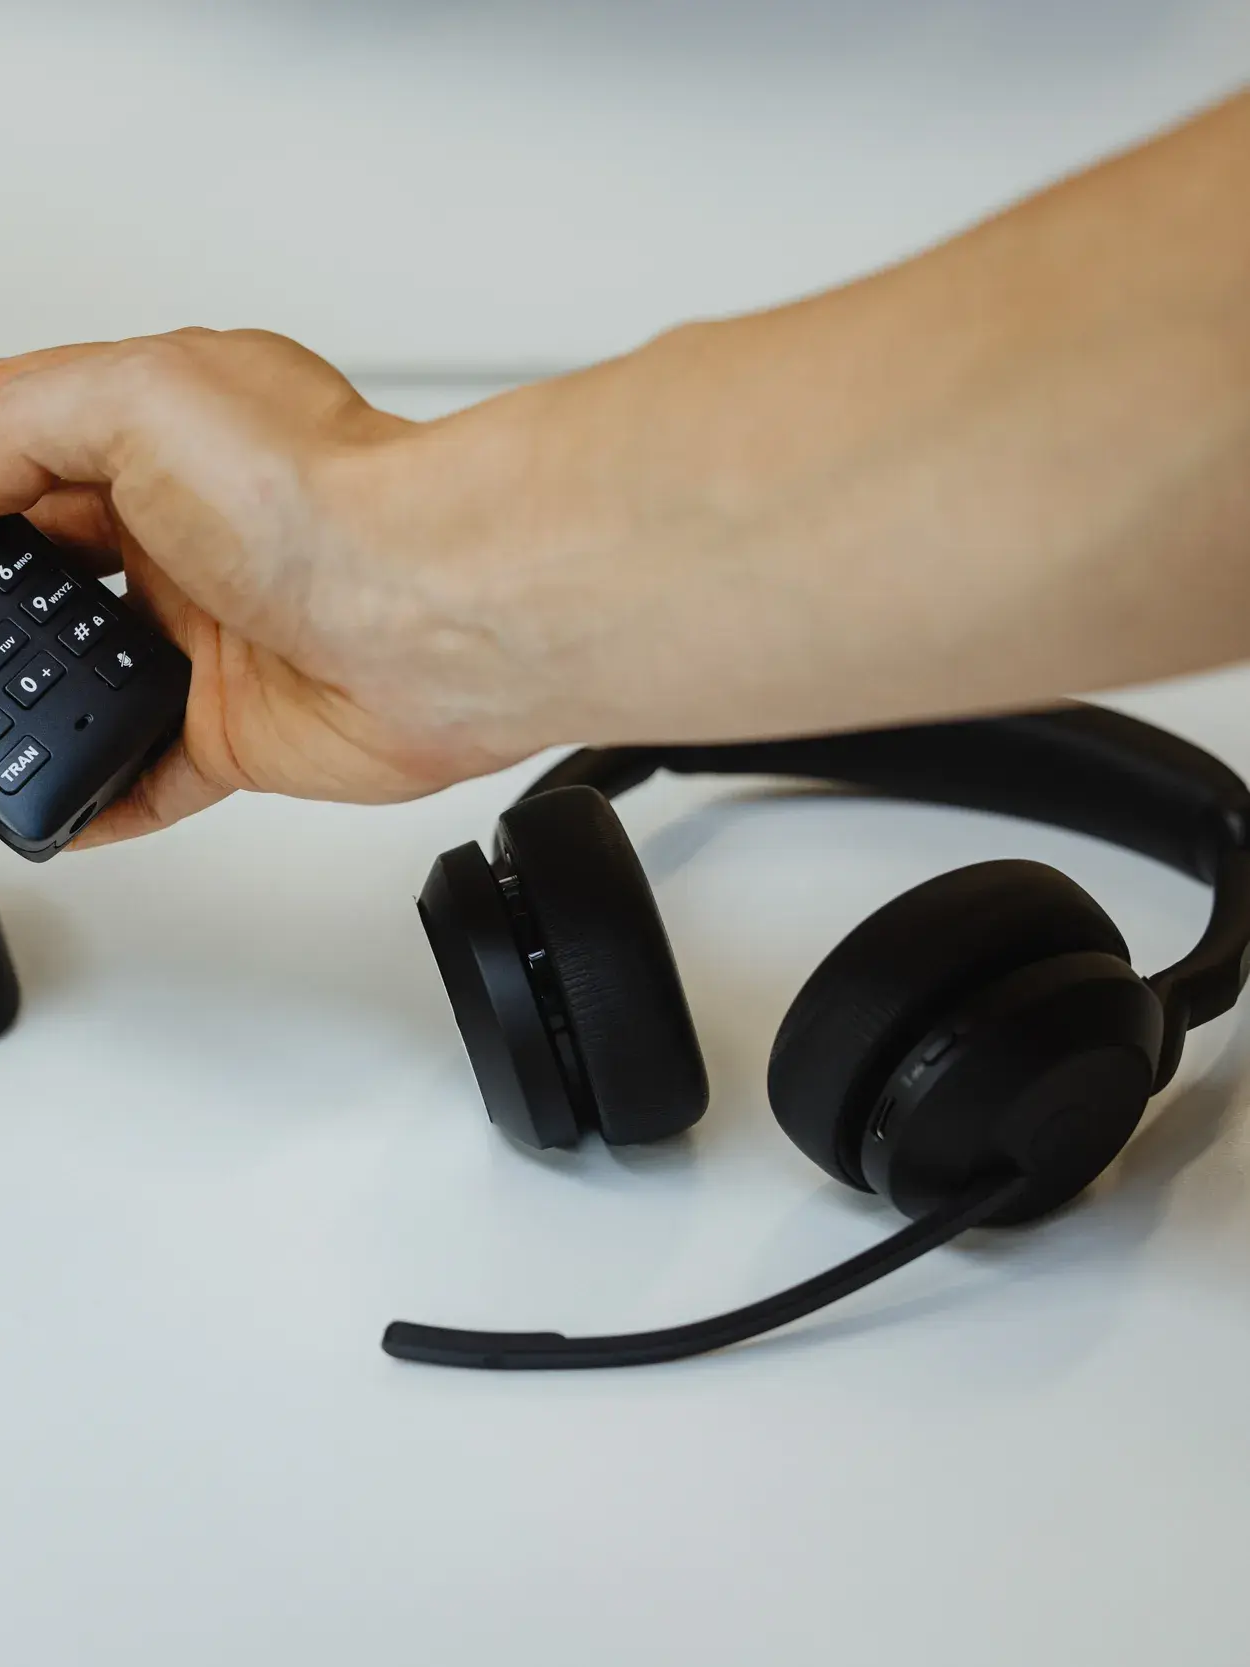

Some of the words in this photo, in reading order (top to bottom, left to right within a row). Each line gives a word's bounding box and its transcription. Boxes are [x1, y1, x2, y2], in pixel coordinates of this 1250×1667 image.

[13, 552, 33, 571] MNO
[32, 596, 48, 612] 9
[48, 581, 73, 605] WXYZ
[73, 622, 90, 641] #
[20, 676, 38, 692] 0
[0, 745, 39, 782] TRAN
